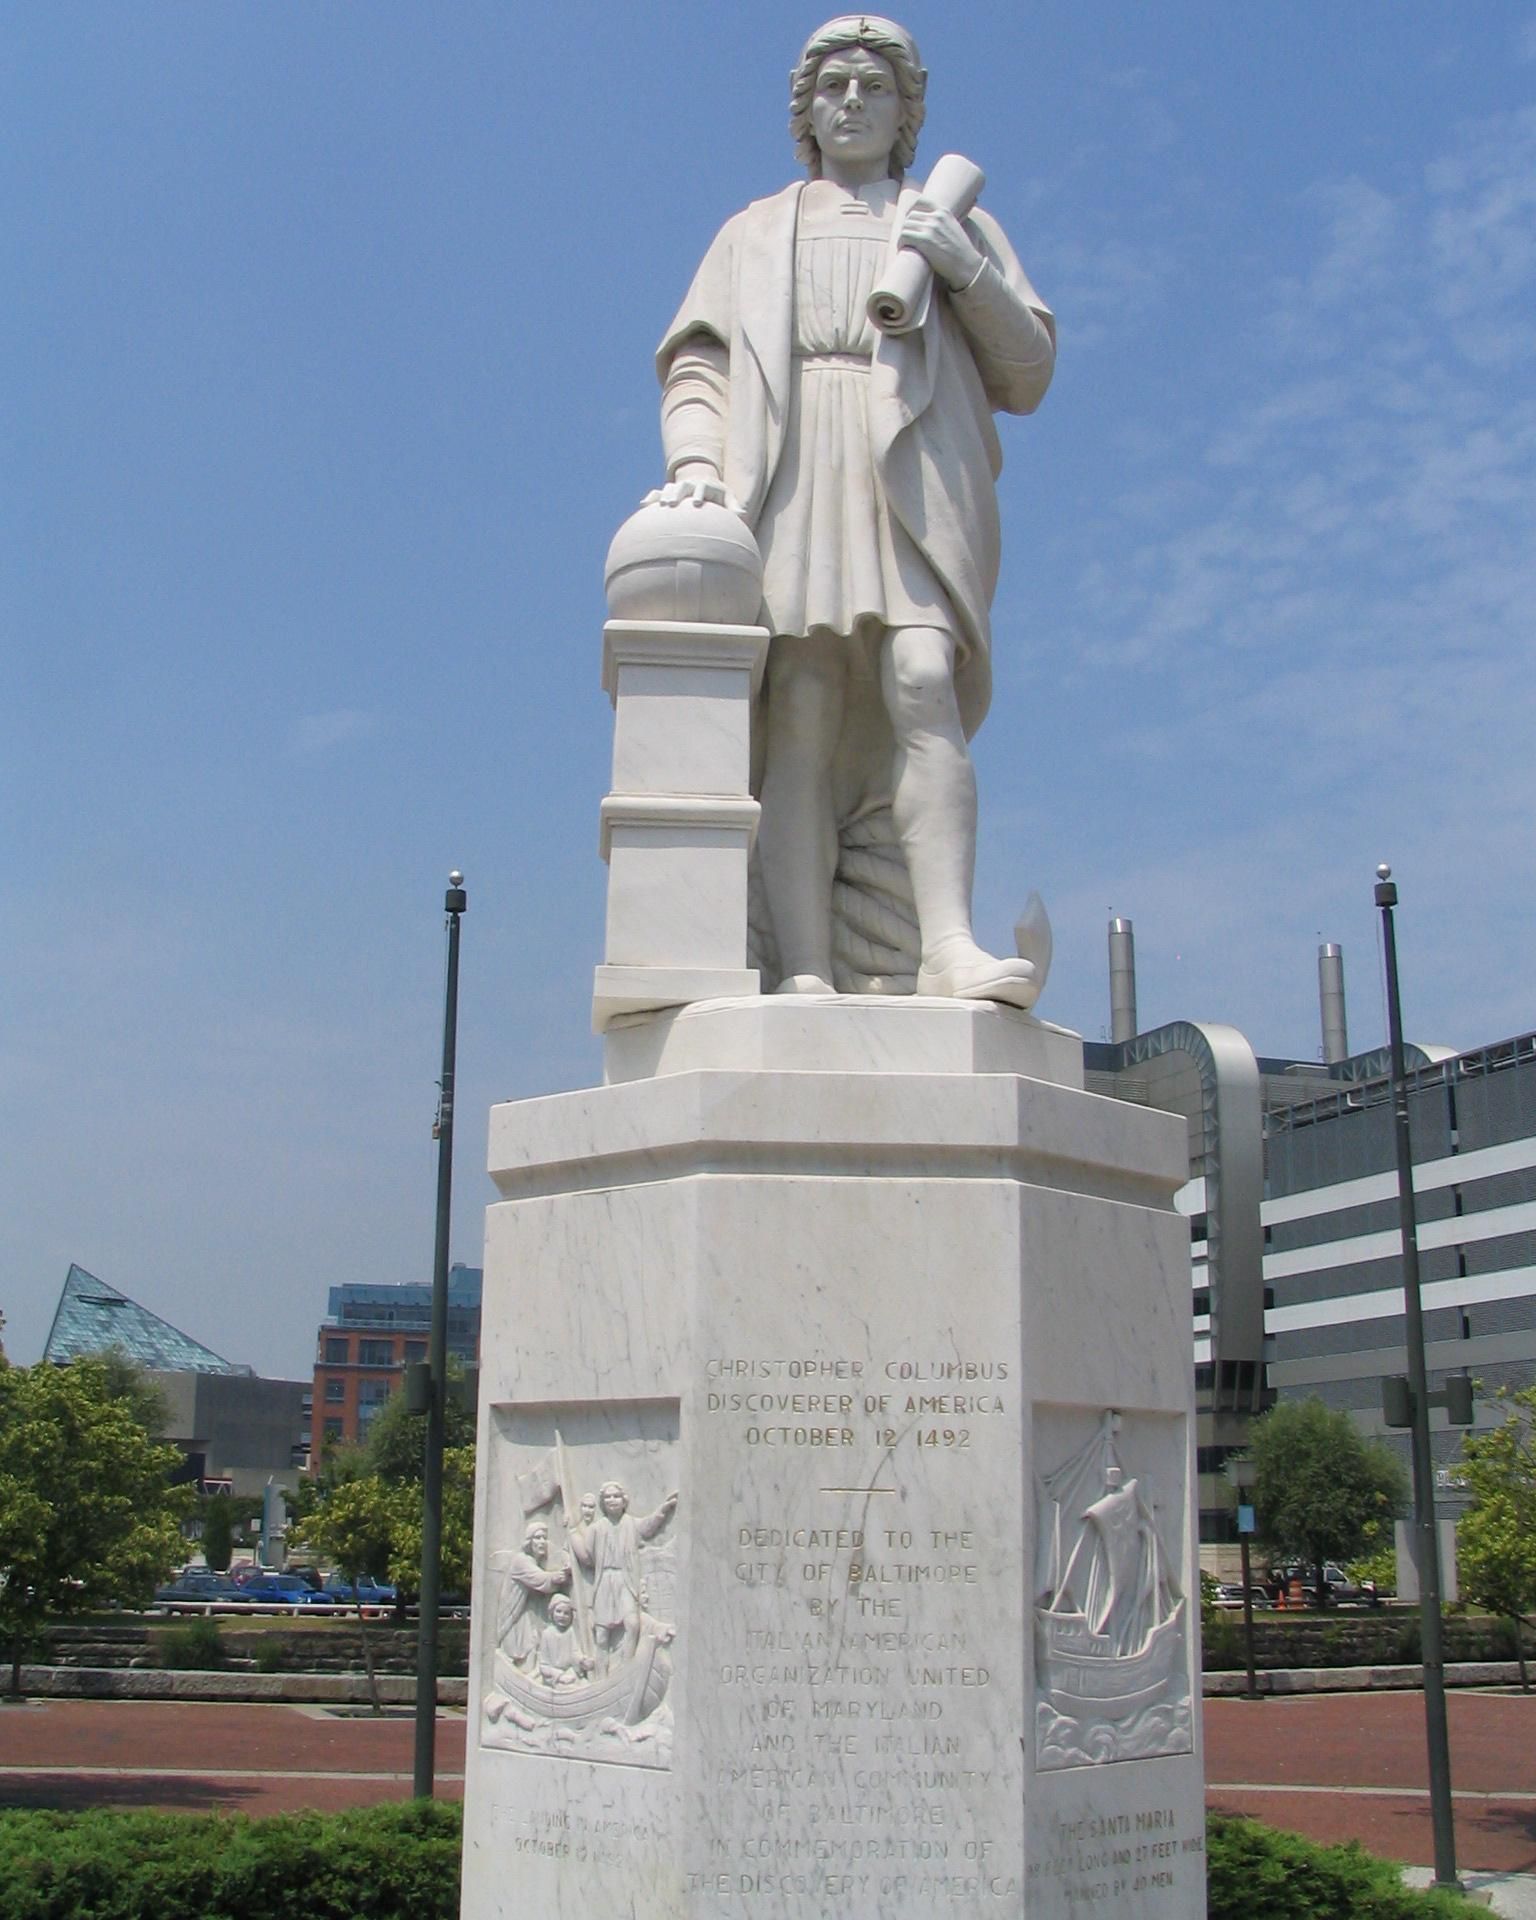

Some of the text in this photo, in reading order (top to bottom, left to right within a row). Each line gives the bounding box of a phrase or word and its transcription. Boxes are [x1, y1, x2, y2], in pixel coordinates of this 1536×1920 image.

[705, 1360, 1008, 1380] CHRISTOPHER COLUMBUS
[708, 1393, 1005, 1413] DISCOVERER OF AMERICA
[746, 1427, 971, 1447] OCTOBER 12 1492
[740, 1529, 974, 1549] DEDICATED TO THE
[735, 1563, 977, 1583] CITY OF BALTIMORE
[810, 1598, 901, 1617] BY THE
[745, 1630, 966, 1651] ITALIAN AMERICAN
[721, 1665, 990, 1686] ORGANIZATION UNITED
[766, 1700, 943, 1720] OF MARYLAND
[751, 1735, 960, 1755] AND THE ITALIAN
[718, 1769, 991, 1789] AMERICAN COMMUNITY
[762, 1804, 943, 1824] OF BALTIMORE
[1090, 1815, 1130, 1838] SANTA
[1136, 1809, 1175, 1830] MARIA
[711, 1839, 992, 1860] IN COMMEMORATION OF
[1152, 1840, 1177, 1858] FEET
[687, 1873, 1017, 1896] THE DISCOVERY OF AMERICA
[1152, 1872, 1173, 1888] MEN
